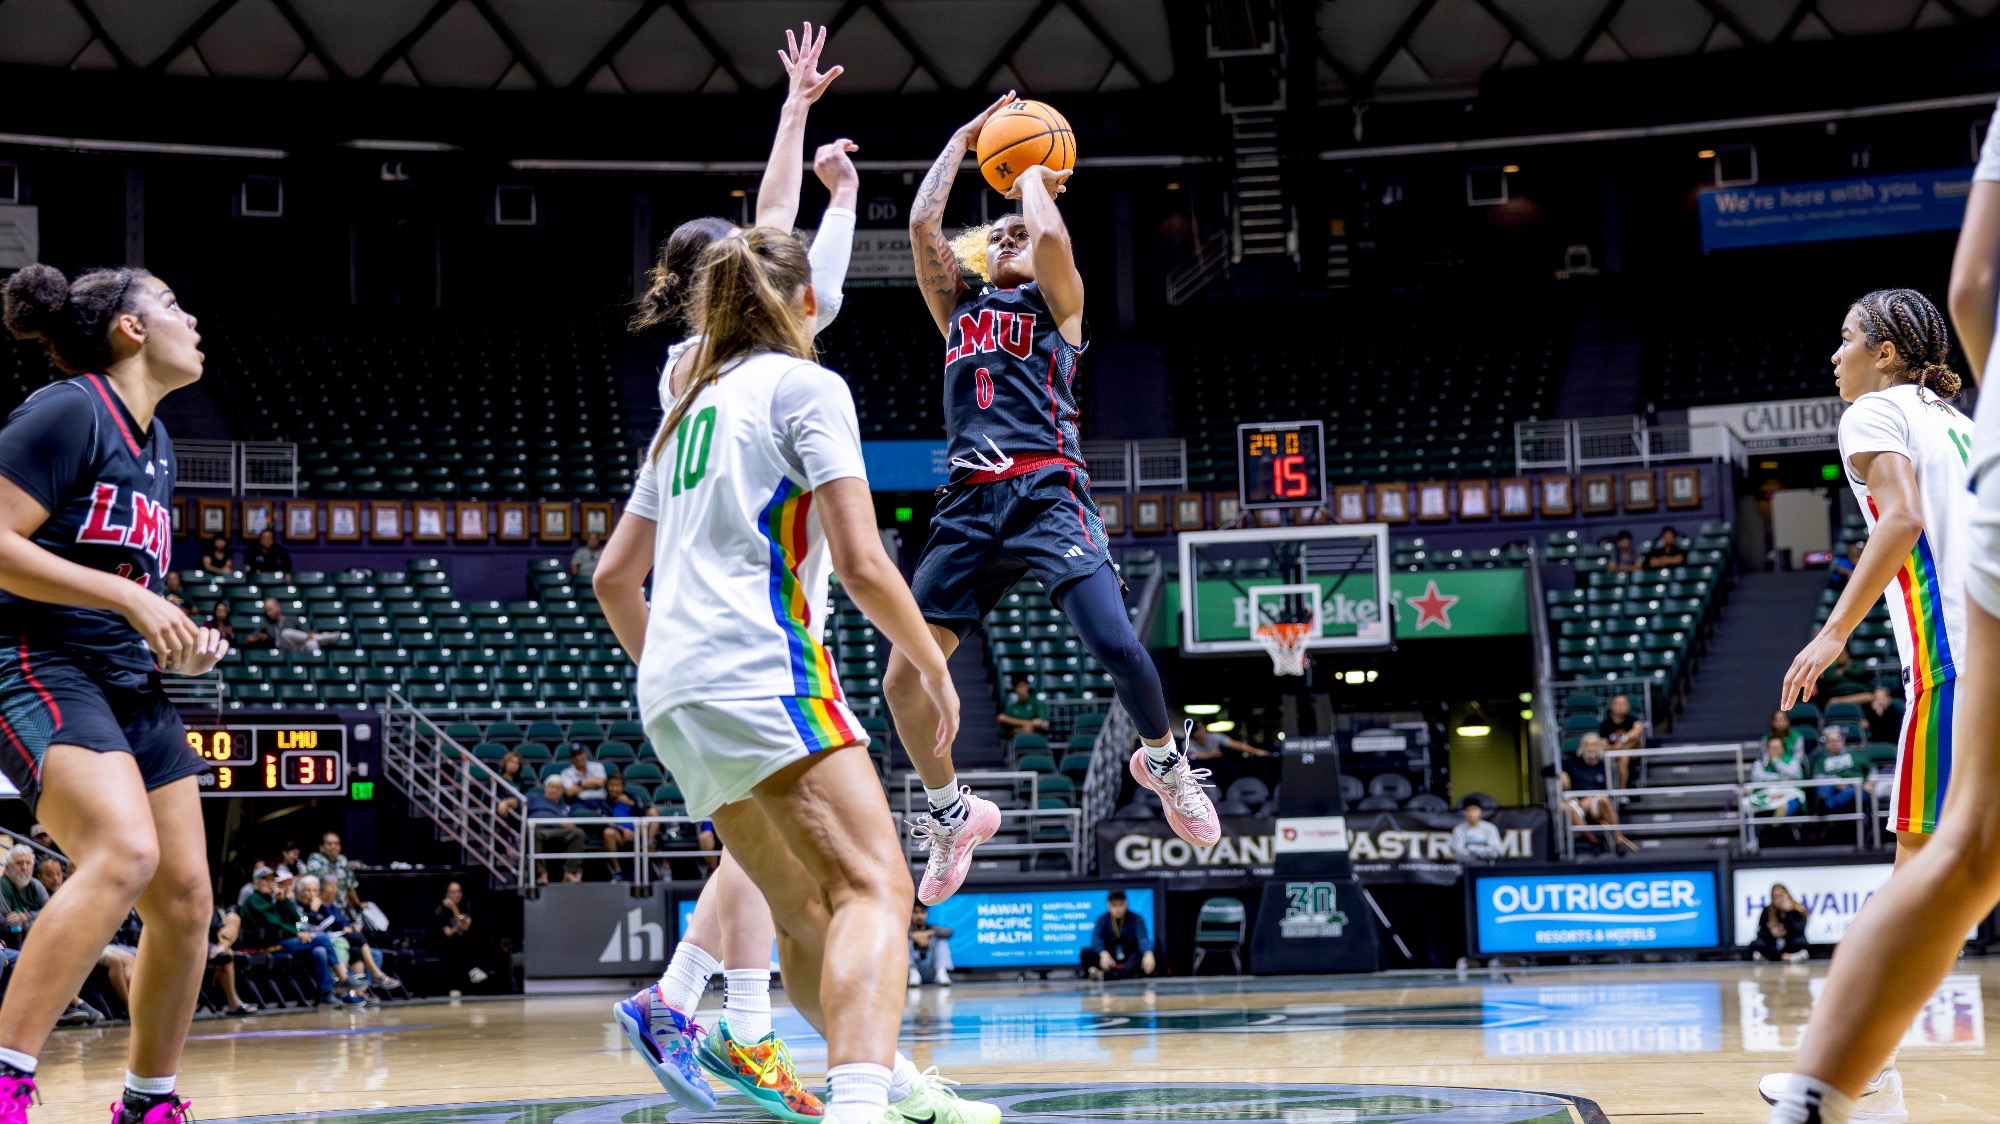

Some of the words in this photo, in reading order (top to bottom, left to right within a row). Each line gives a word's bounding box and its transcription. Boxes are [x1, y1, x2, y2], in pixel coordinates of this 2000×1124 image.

[1714, 190, 1775, 214] We're
[1780, 187, 1825, 208] here
[1830, 181, 1875, 202] with
[975, 368, 994, 409] 0
[671, 406, 717, 497] 10
[1273, 455, 1308, 498] 15
[75, 481, 172, 579] LMU
[278, 731, 318, 749] LMU
[219, 767, 232, 788] 3
[300, 756, 333, 784] 31
[1492, 879, 1696, 914] OUTRIGGER
[977, 916, 1033, 930] PACIFIC
[977, 930, 1033, 945] HEALTH
[1535, 929, 1593, 944] RESORTS
[1594, 929, 1604, 942] &
[1605, 927, 1657, 942] HOTELS
